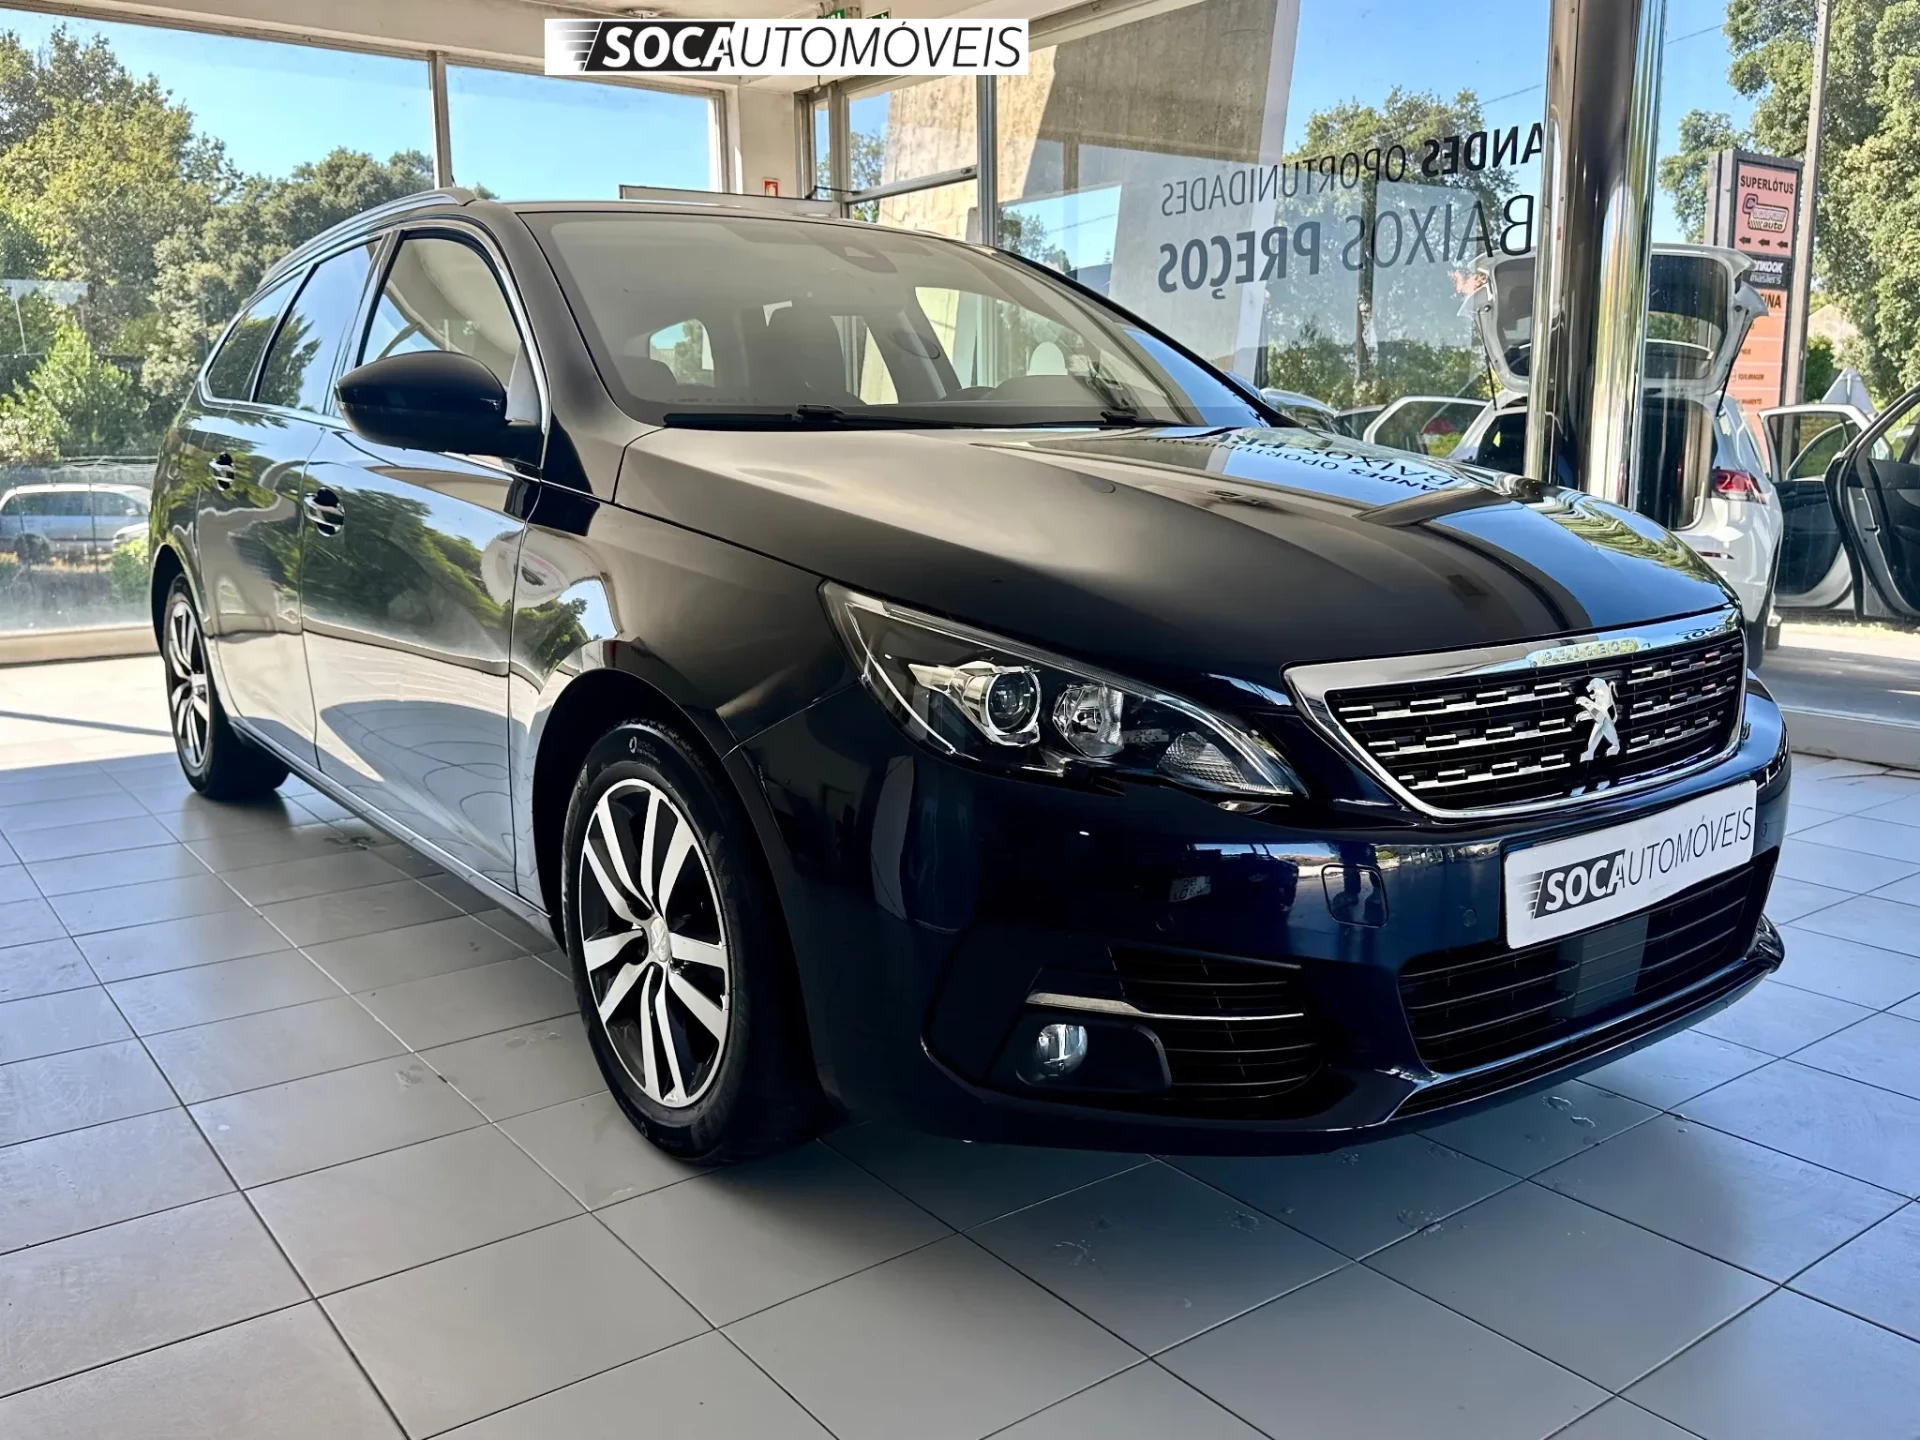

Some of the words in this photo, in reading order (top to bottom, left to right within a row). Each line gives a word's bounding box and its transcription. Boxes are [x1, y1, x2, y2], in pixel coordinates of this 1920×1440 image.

[1740, 175, 1794, 195] SUPERLÓTUS
[1763, 220, 1783, 230] auto
[1349, 468, 1439, 491] ANDES
[1544, 806, 1754, 911] SOCAUTOMÓVEIS
